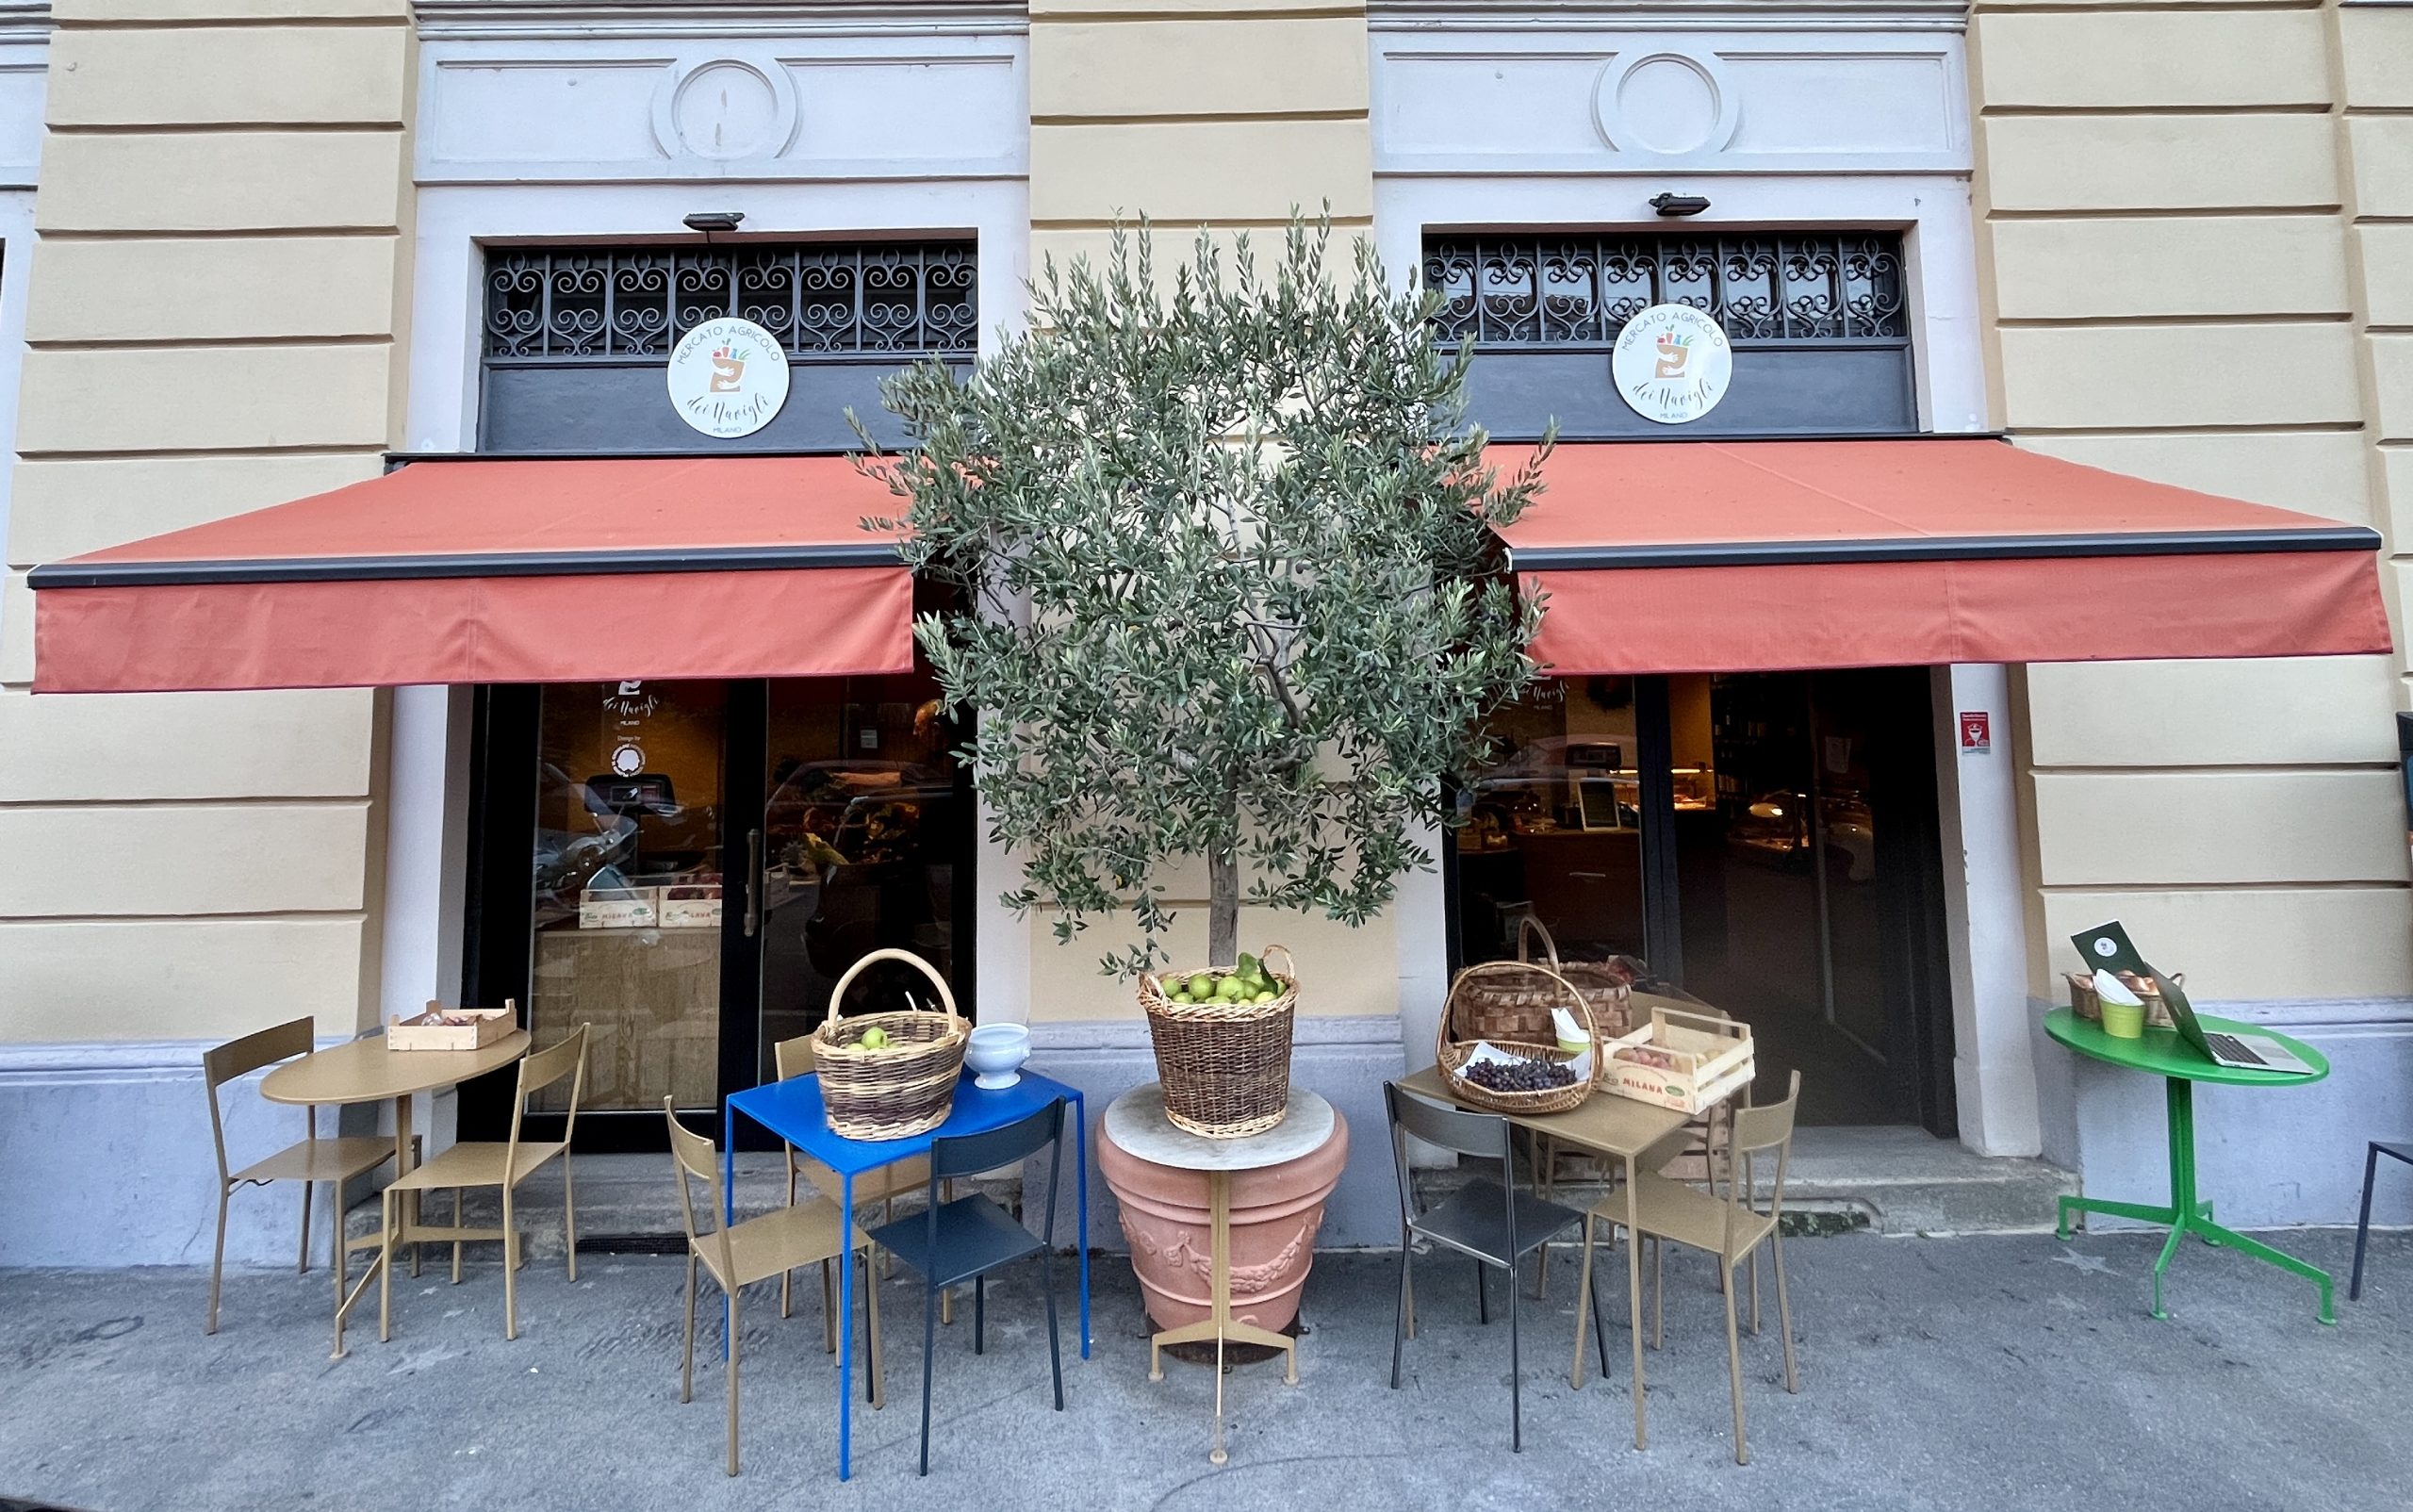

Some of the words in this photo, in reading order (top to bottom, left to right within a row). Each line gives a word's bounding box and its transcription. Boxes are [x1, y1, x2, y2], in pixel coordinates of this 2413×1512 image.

[677, 326, 723, 365] MERCATO
[729, 325, 780, 361] AGRICOLO
[1621, 312, 1666, 352] MERCATO
[1671, 311, 1723, 348] AGRICOLO
[686, 396, 709, 415] dei
[714, 392, 769, 424] Navigli
[1633, 382, 1655, 400] dei
[1659, 378, 1714, 410] Navigli
[1622, 1077, 1663, 1094] MILANA
